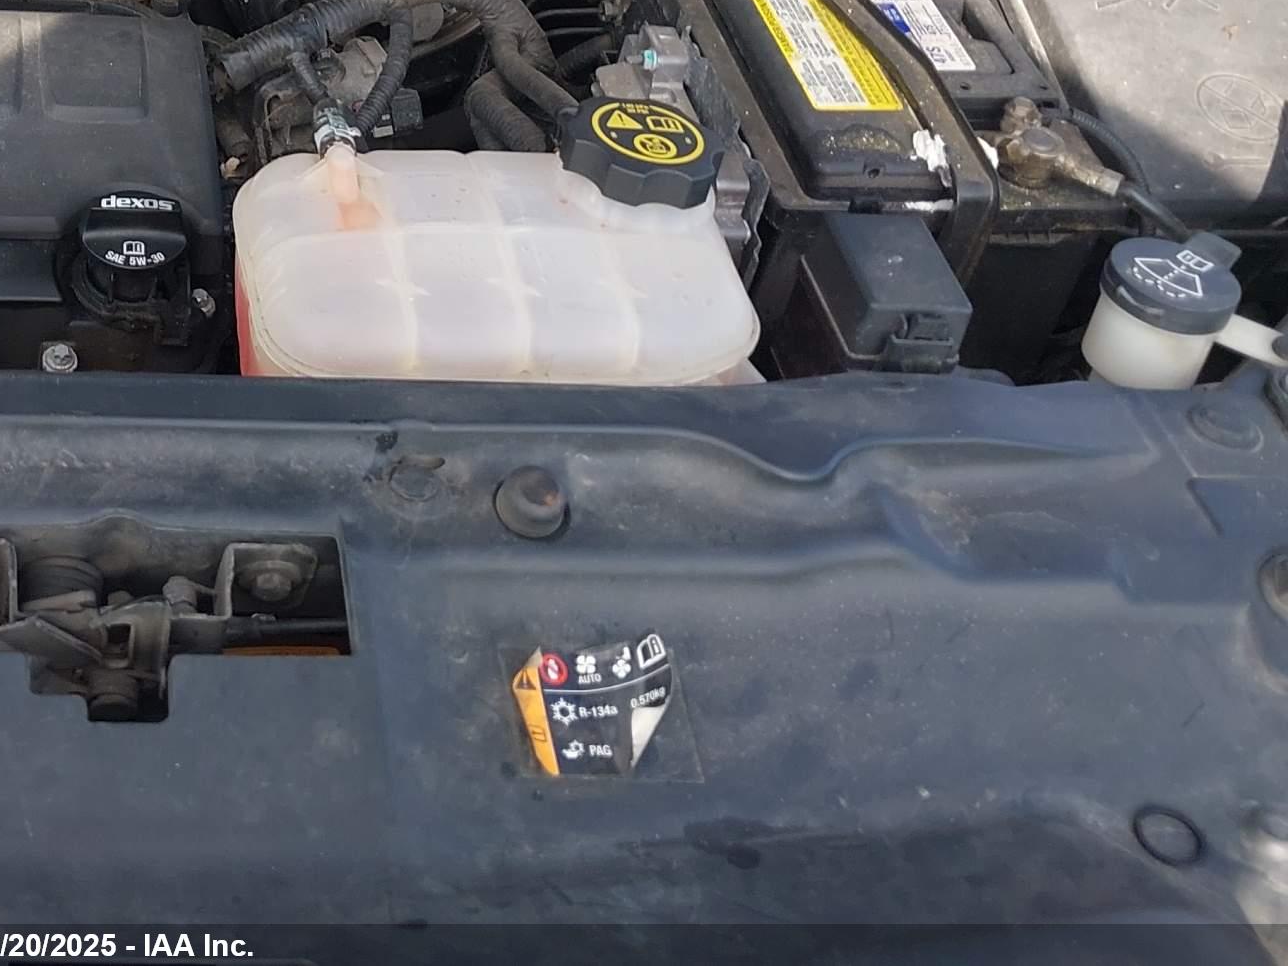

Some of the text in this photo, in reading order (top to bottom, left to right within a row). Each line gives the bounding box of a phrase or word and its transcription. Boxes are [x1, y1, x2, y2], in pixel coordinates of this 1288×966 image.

[101, 195, 175, 210] dexos
[104, 250, 166, 266] SAE 5W-30
[578, 673, 602, 684] AUTO
[578, 703, 619, 718] R-134a
[589, 743, 613, 757] PAG
